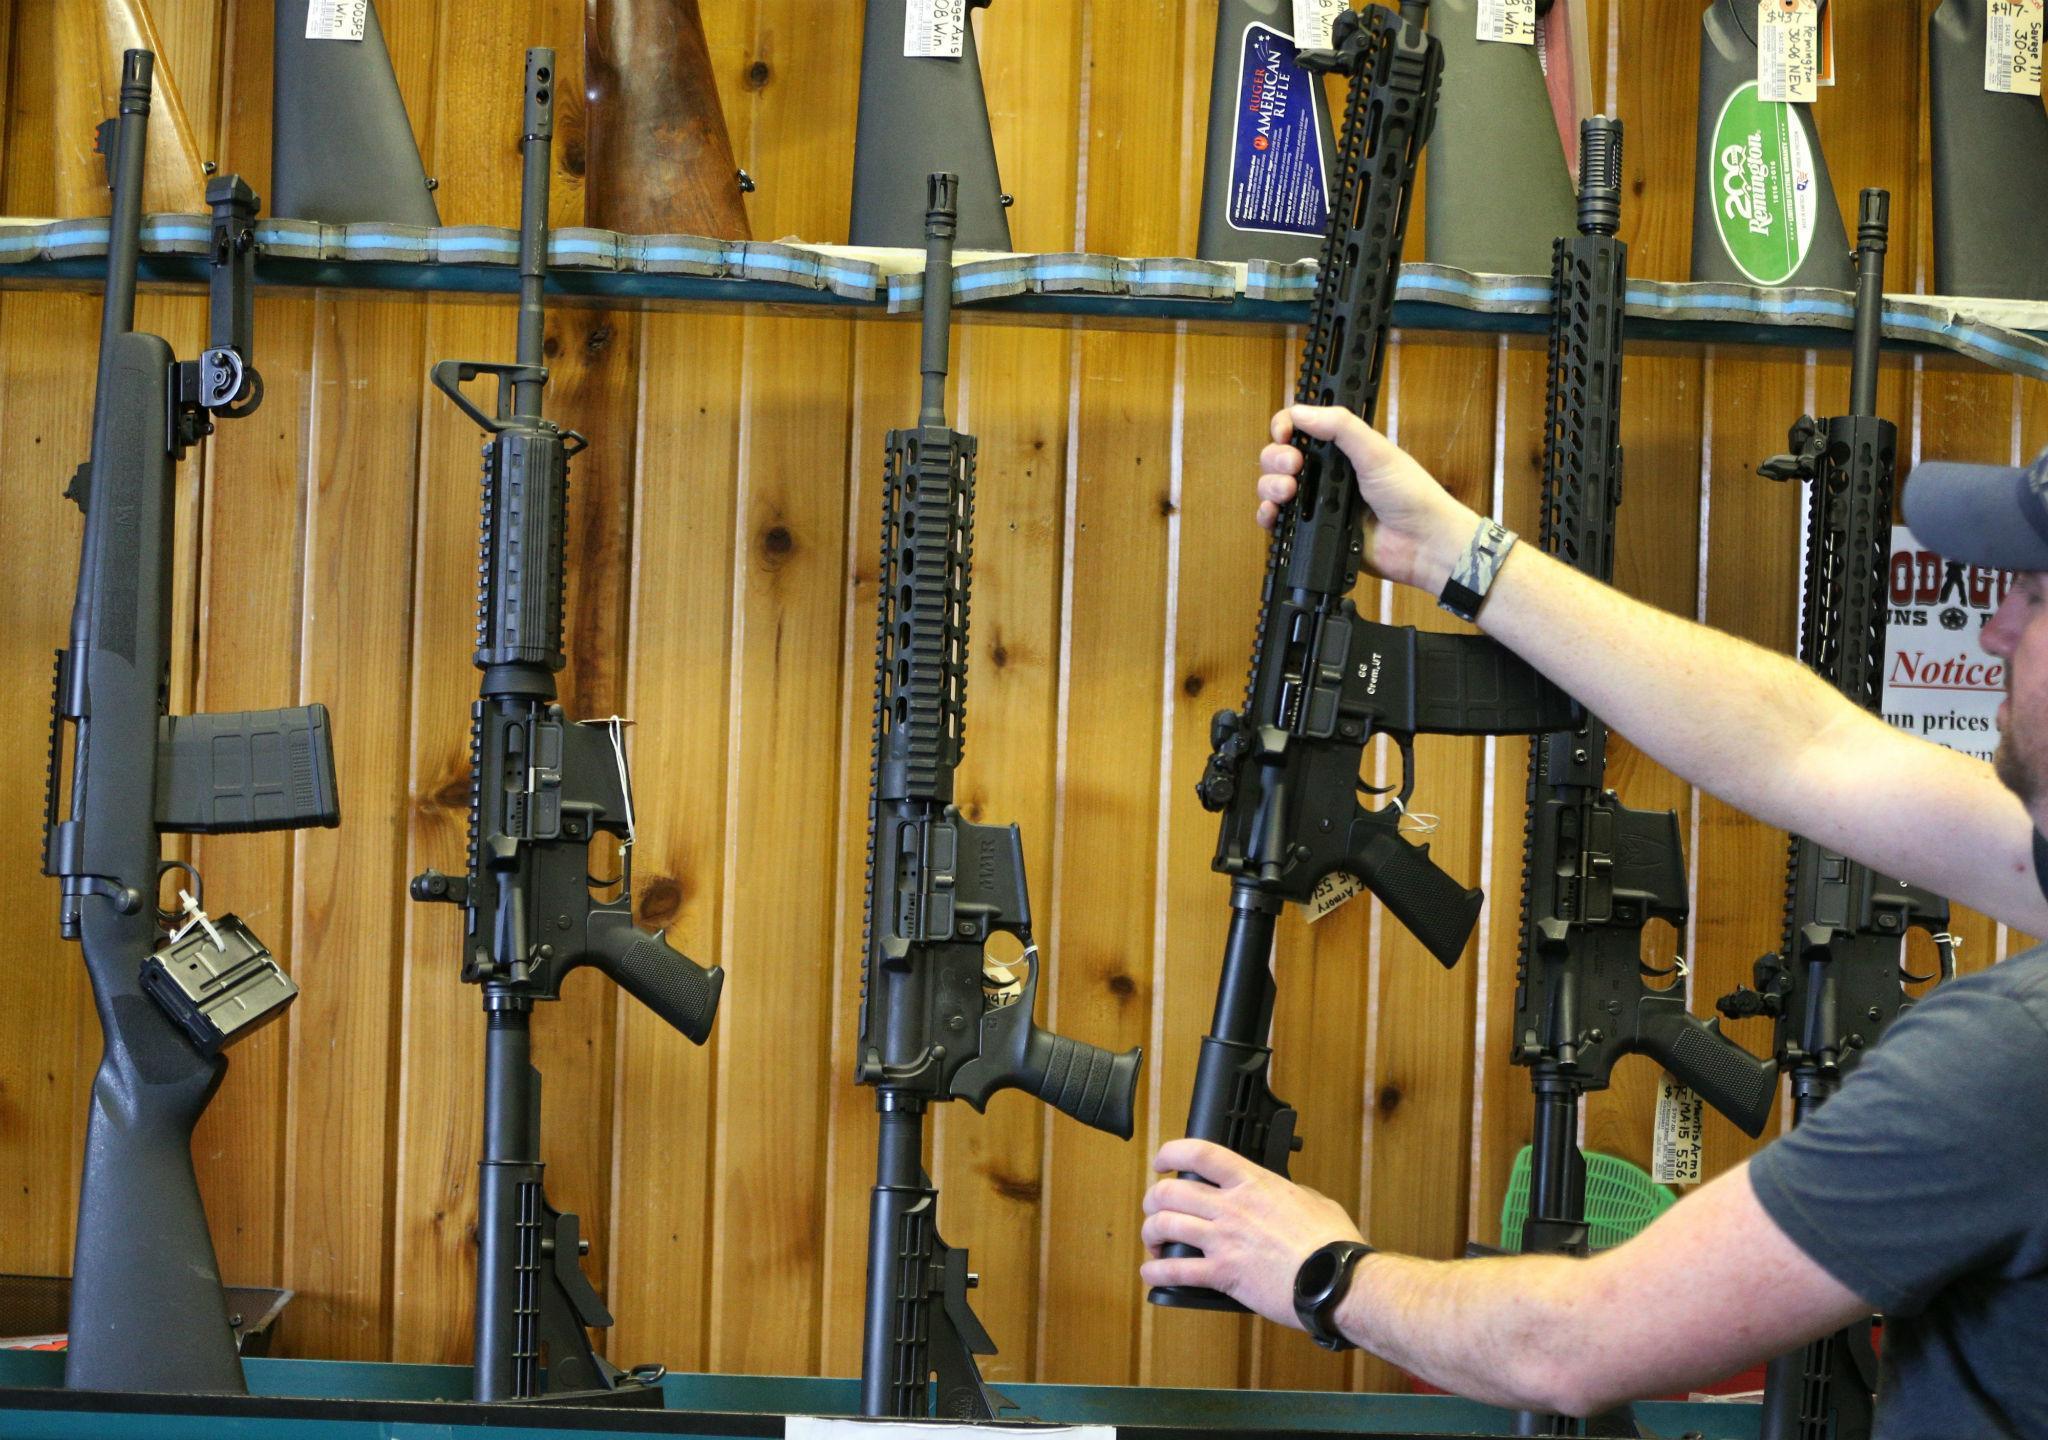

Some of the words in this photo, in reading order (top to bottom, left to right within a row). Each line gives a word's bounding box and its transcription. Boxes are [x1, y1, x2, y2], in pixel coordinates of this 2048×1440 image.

[335, 2, 349, 28] Win
[1321, 13, 1334, 37] Win
[1504, 11, 1520, 35] Win
[951, 25, 965, 54] Axis
[1788, 28, 1801, 60] 30-06
[1801, 25, 1817, 84] Remington
[2028, 22, 2042, 60] Savage
[1250, 68, 1266, 112] RUGER
[1788, 64, 1803, 96] NEW
[2029, 66, 2042, 83] 111
[1257, 50, 1283, 138] AMERICAN
[1273, 72, 1291, 118] RIFLE
[1721, 144, 1751, 220] 200
[1748, 131, 1774, 237] Remington
[1888, 651, 2003, 686] Notice
[1884, 712, 1915, 729] un
[1922, 709, 1990, 736] prices
[1318, 886, 1354, 914] Armory
[1678, 1102, 1692, 1139] MA-15
[1691, 1100, 1703, 1139] Mantis
[1676, 1149, 1690, 1179] 5.56
